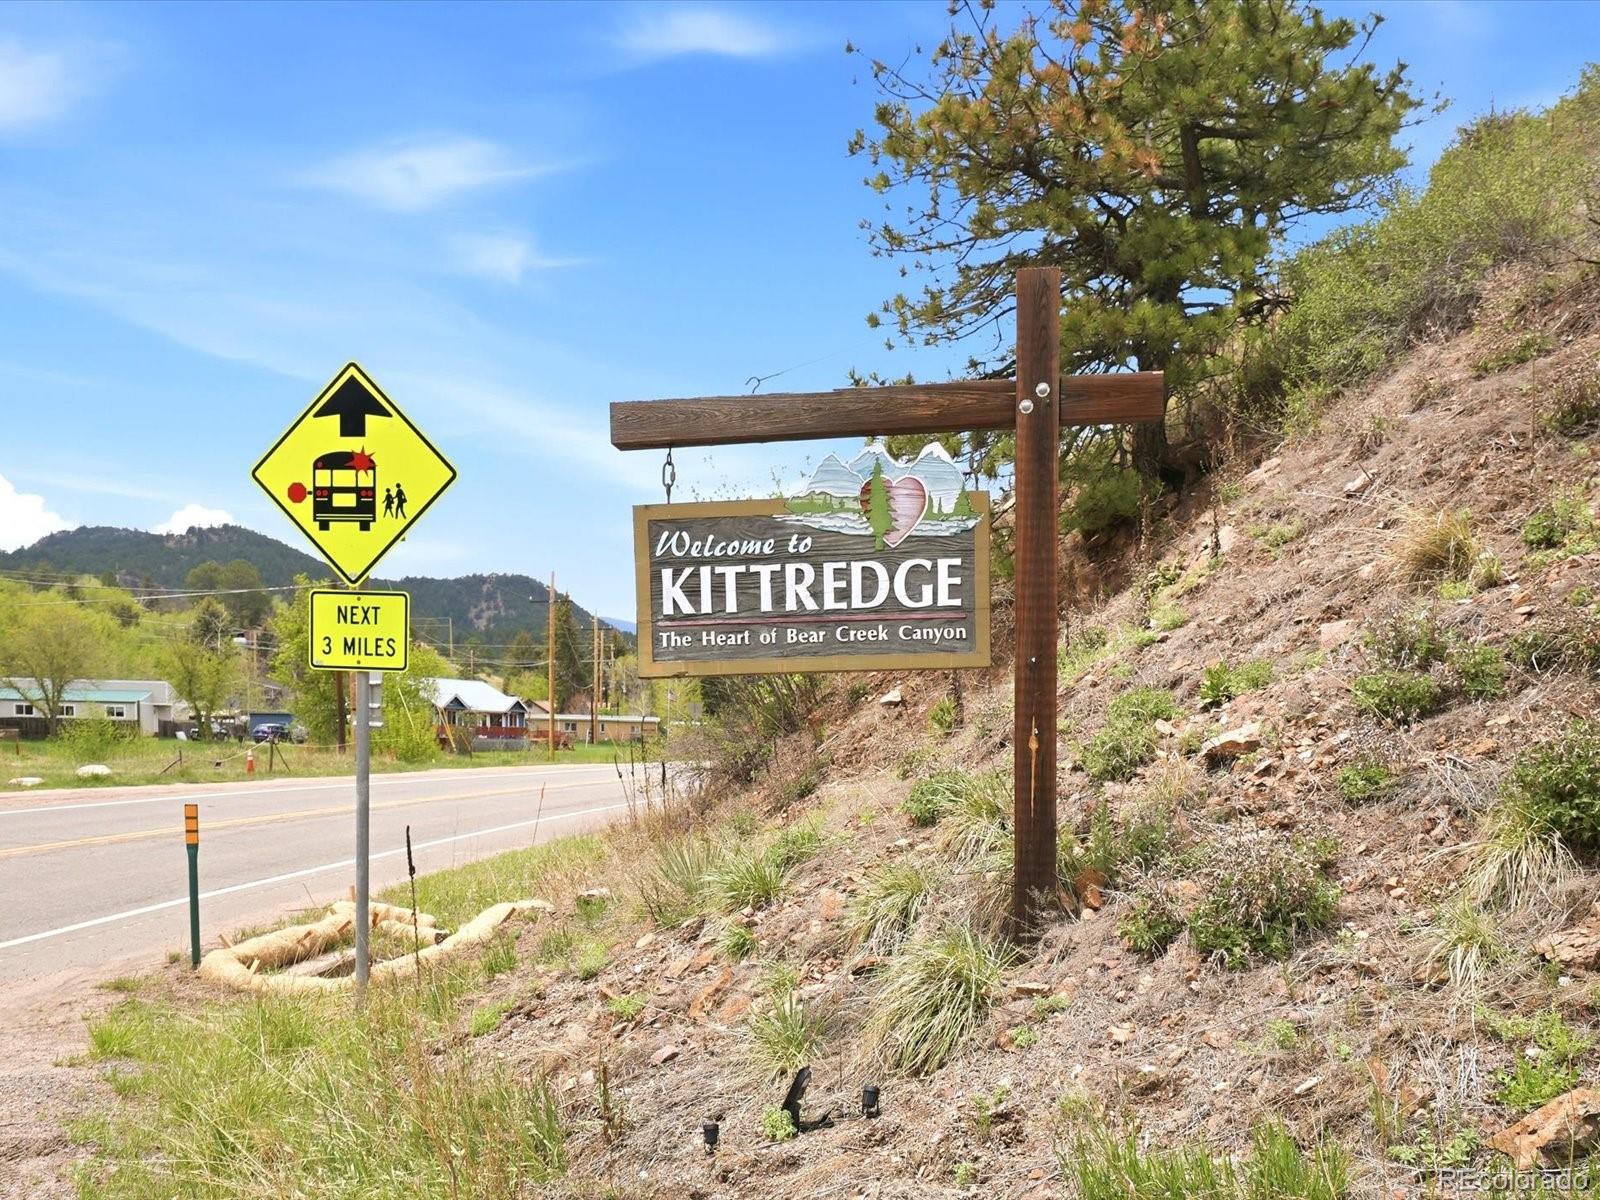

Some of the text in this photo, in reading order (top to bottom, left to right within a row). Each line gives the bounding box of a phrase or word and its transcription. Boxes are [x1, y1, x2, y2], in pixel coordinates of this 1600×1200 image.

[655, 530, 812, 558] Welcome to
[661, 557, 962, 615] KITTREDGE
[337, 605, 380, 625] NEXT
[322, 636, 396, 657] 3 MILES
[659, 625, 967, 648] The Heart of Bear Creek Canyon
